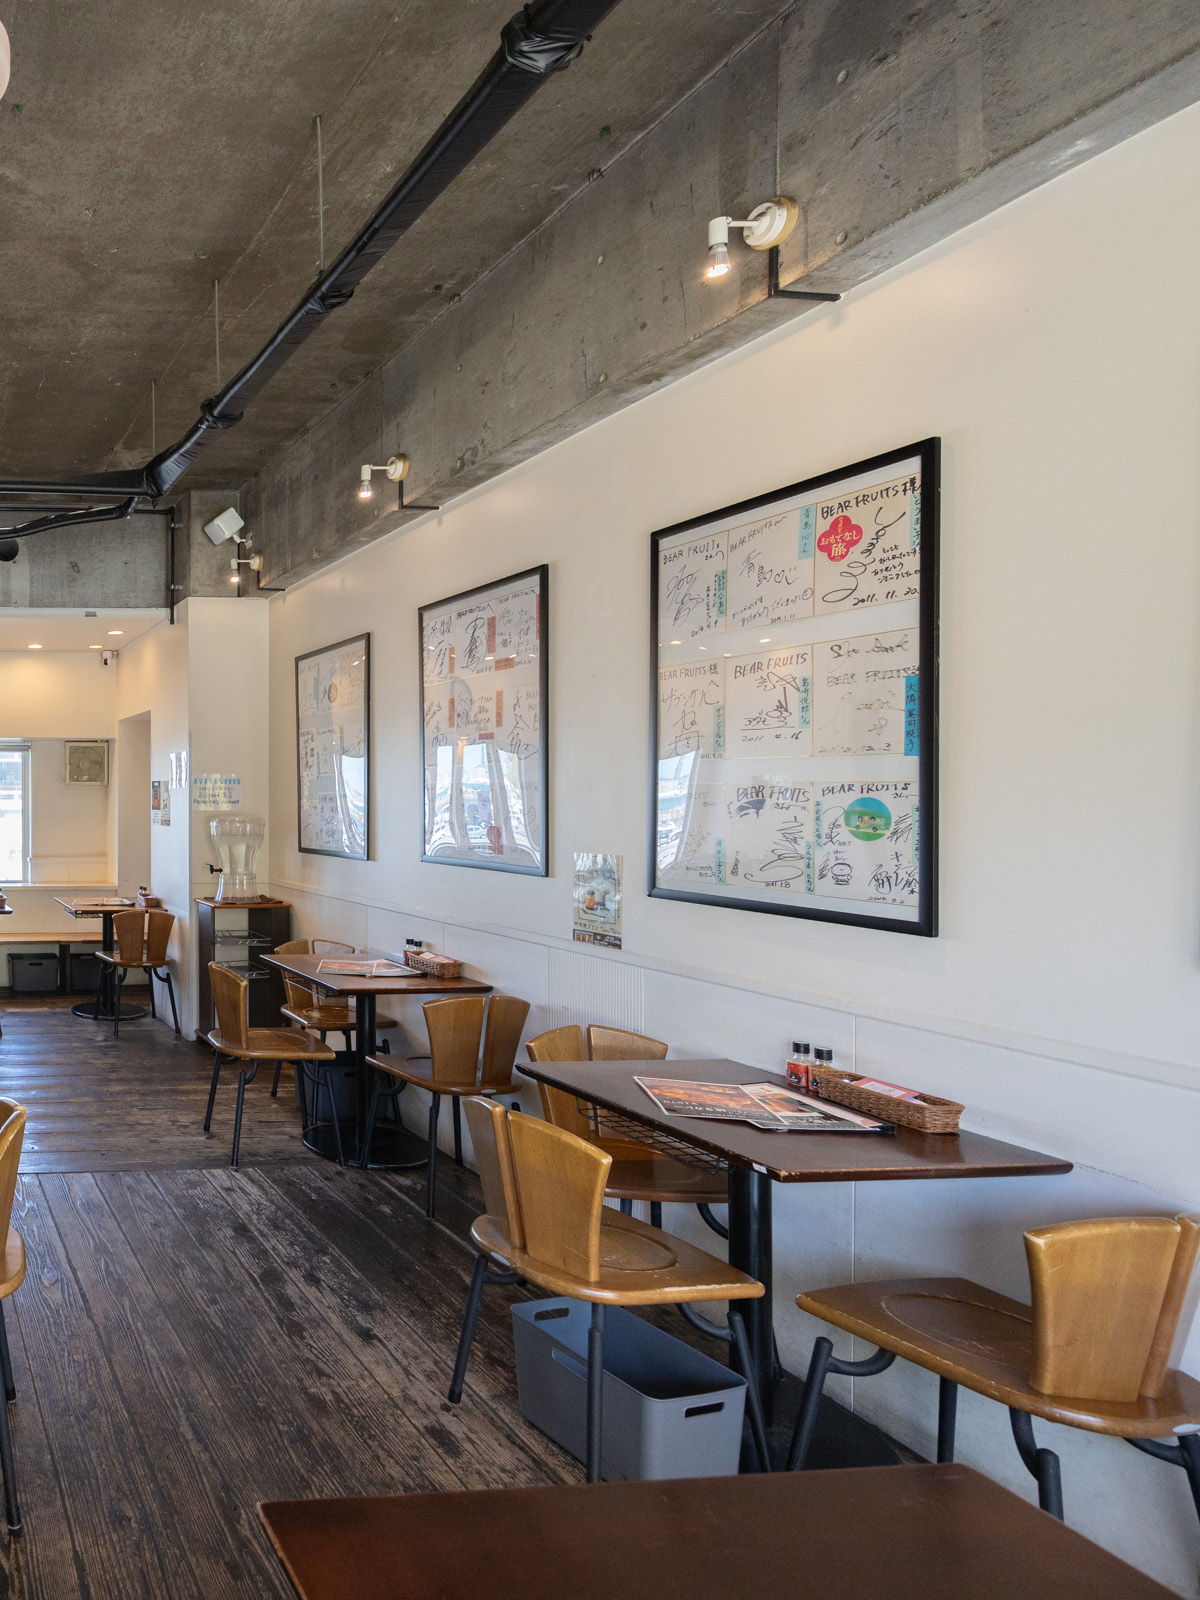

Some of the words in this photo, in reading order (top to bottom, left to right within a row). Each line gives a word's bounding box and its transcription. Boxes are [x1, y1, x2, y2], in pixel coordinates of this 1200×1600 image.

[821, 500, 852, 520] BEAR
[854, 484, 899, 507] FRUITS
[730, 536, 747, 553] BEAR
[748, 520, 773, 542] FRUITS
[819, 529, 860, 546] おもてなし
[663, 549, 684, 566] BEAR
[659, 669, 678, 681] BEAR
[680, 665, 707, 679] FRUITS
[734, 661, 764, 680] BEAR
[766, 652, 808, 670] FRUITS
[737, 785, 765, 802] BEAR
[769, 785, 810, 803] FRUITS
[822, 783, 856, 797] BEAR
[860, 782, 911, 794] FRUITS
